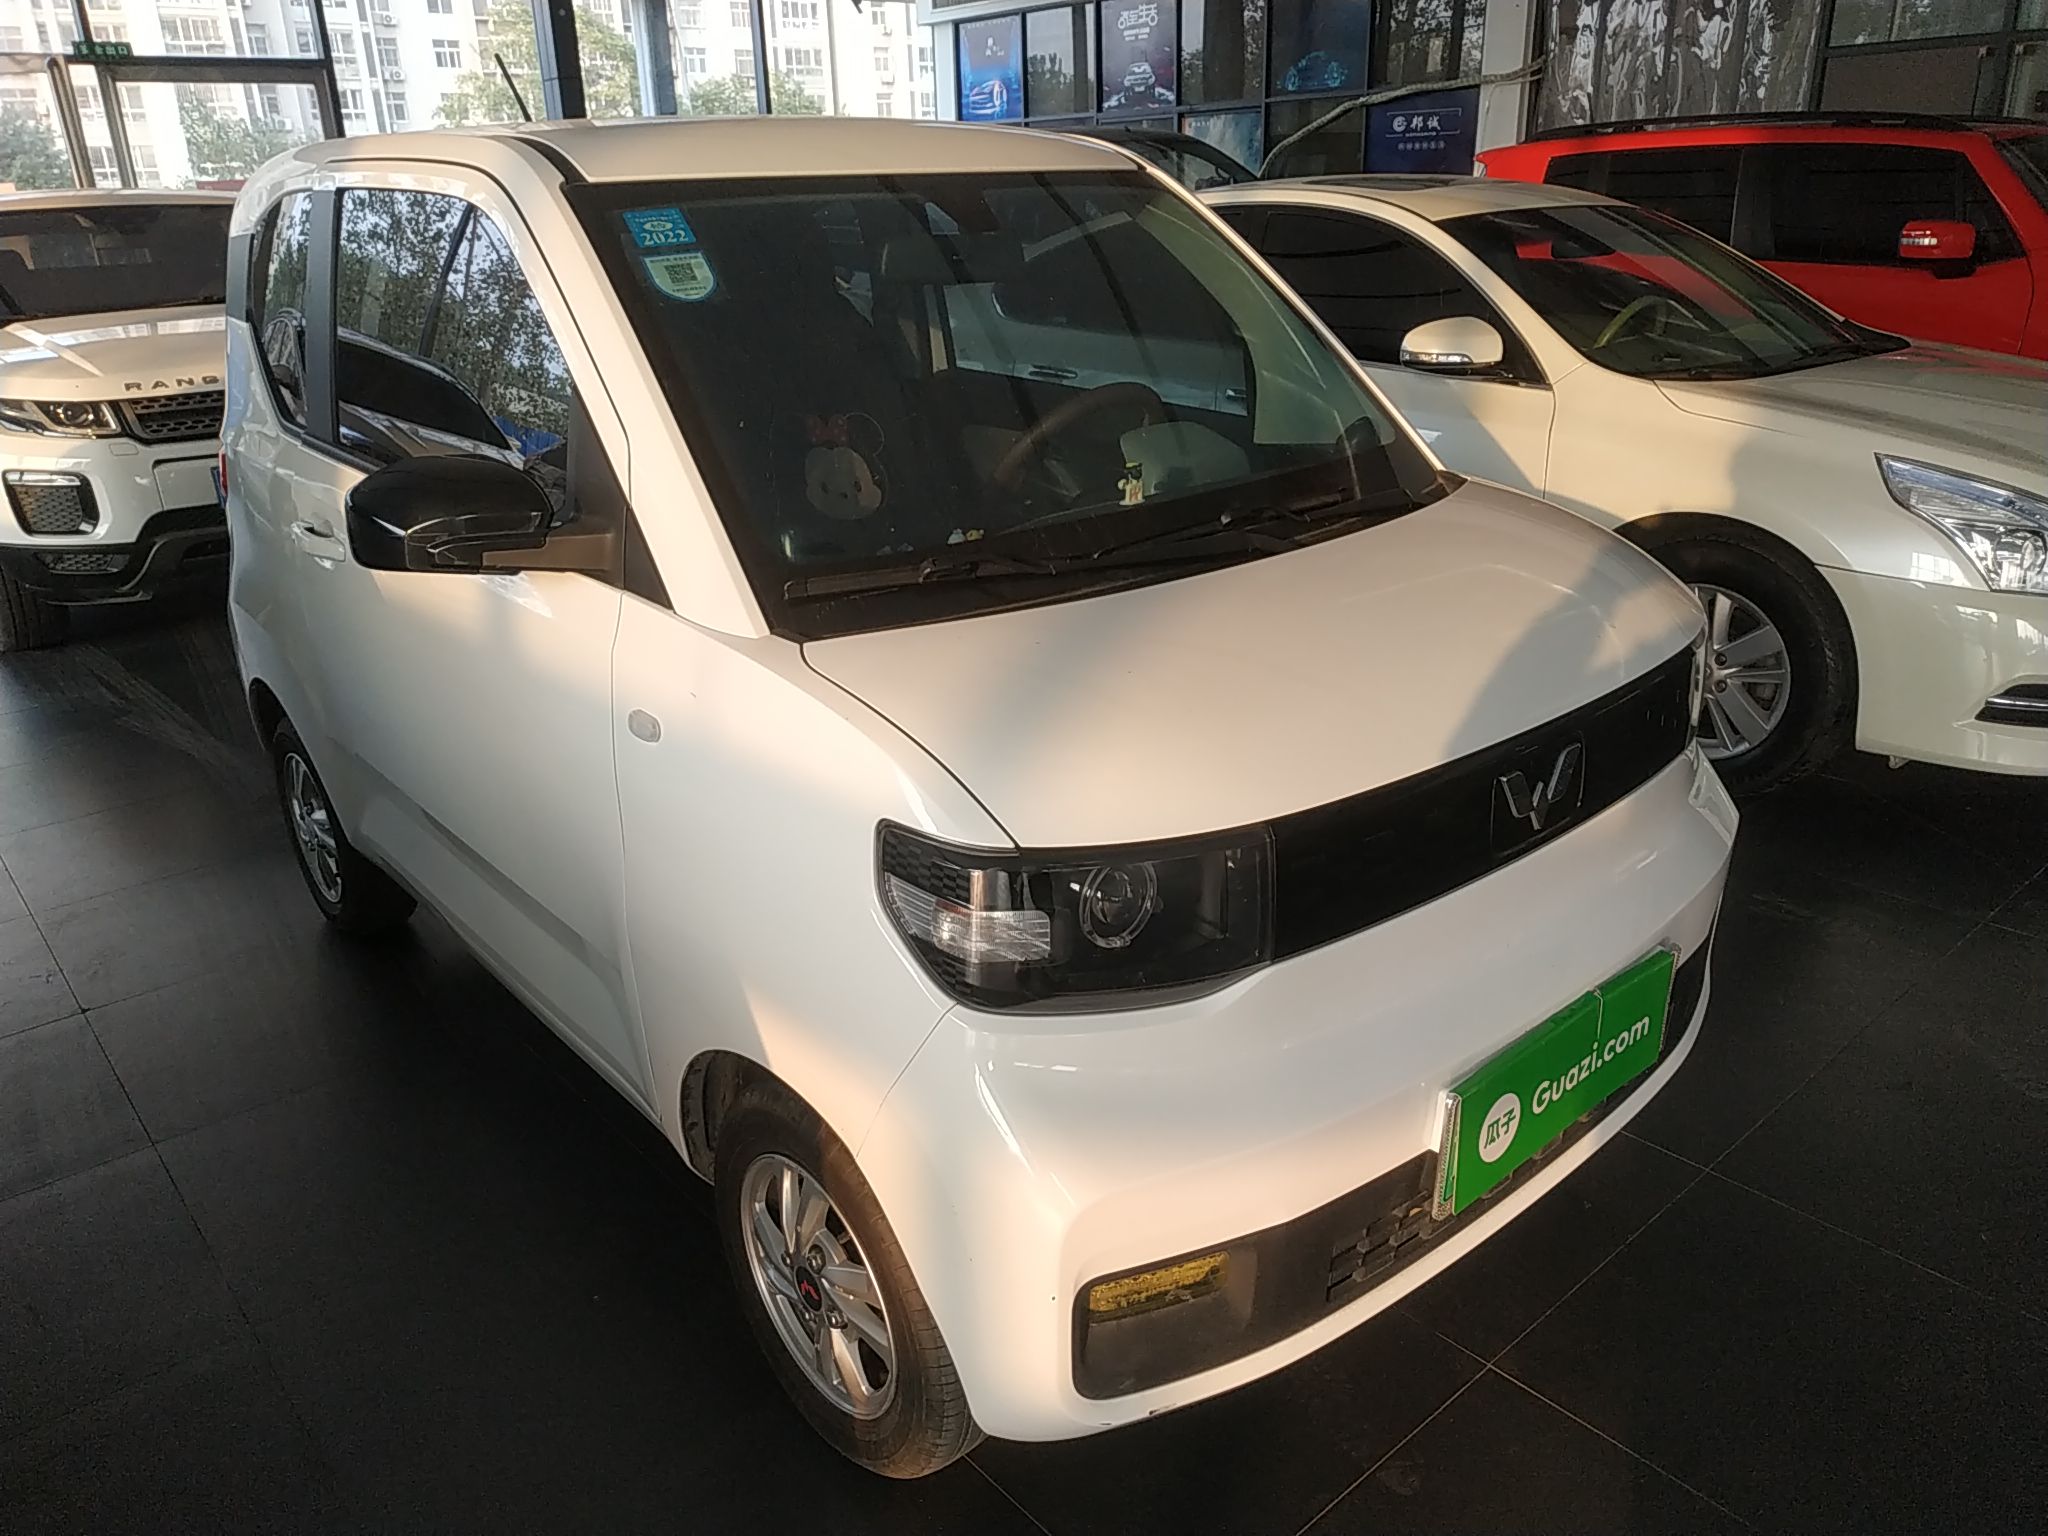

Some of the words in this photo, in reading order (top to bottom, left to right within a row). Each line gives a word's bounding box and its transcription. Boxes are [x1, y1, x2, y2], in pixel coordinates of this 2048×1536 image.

[640, 230, 689, 245] 2022
[1484, 1106, 1517, 1149] 瓜子
[1532, 1016, 1649, 1115] Guazi.com
